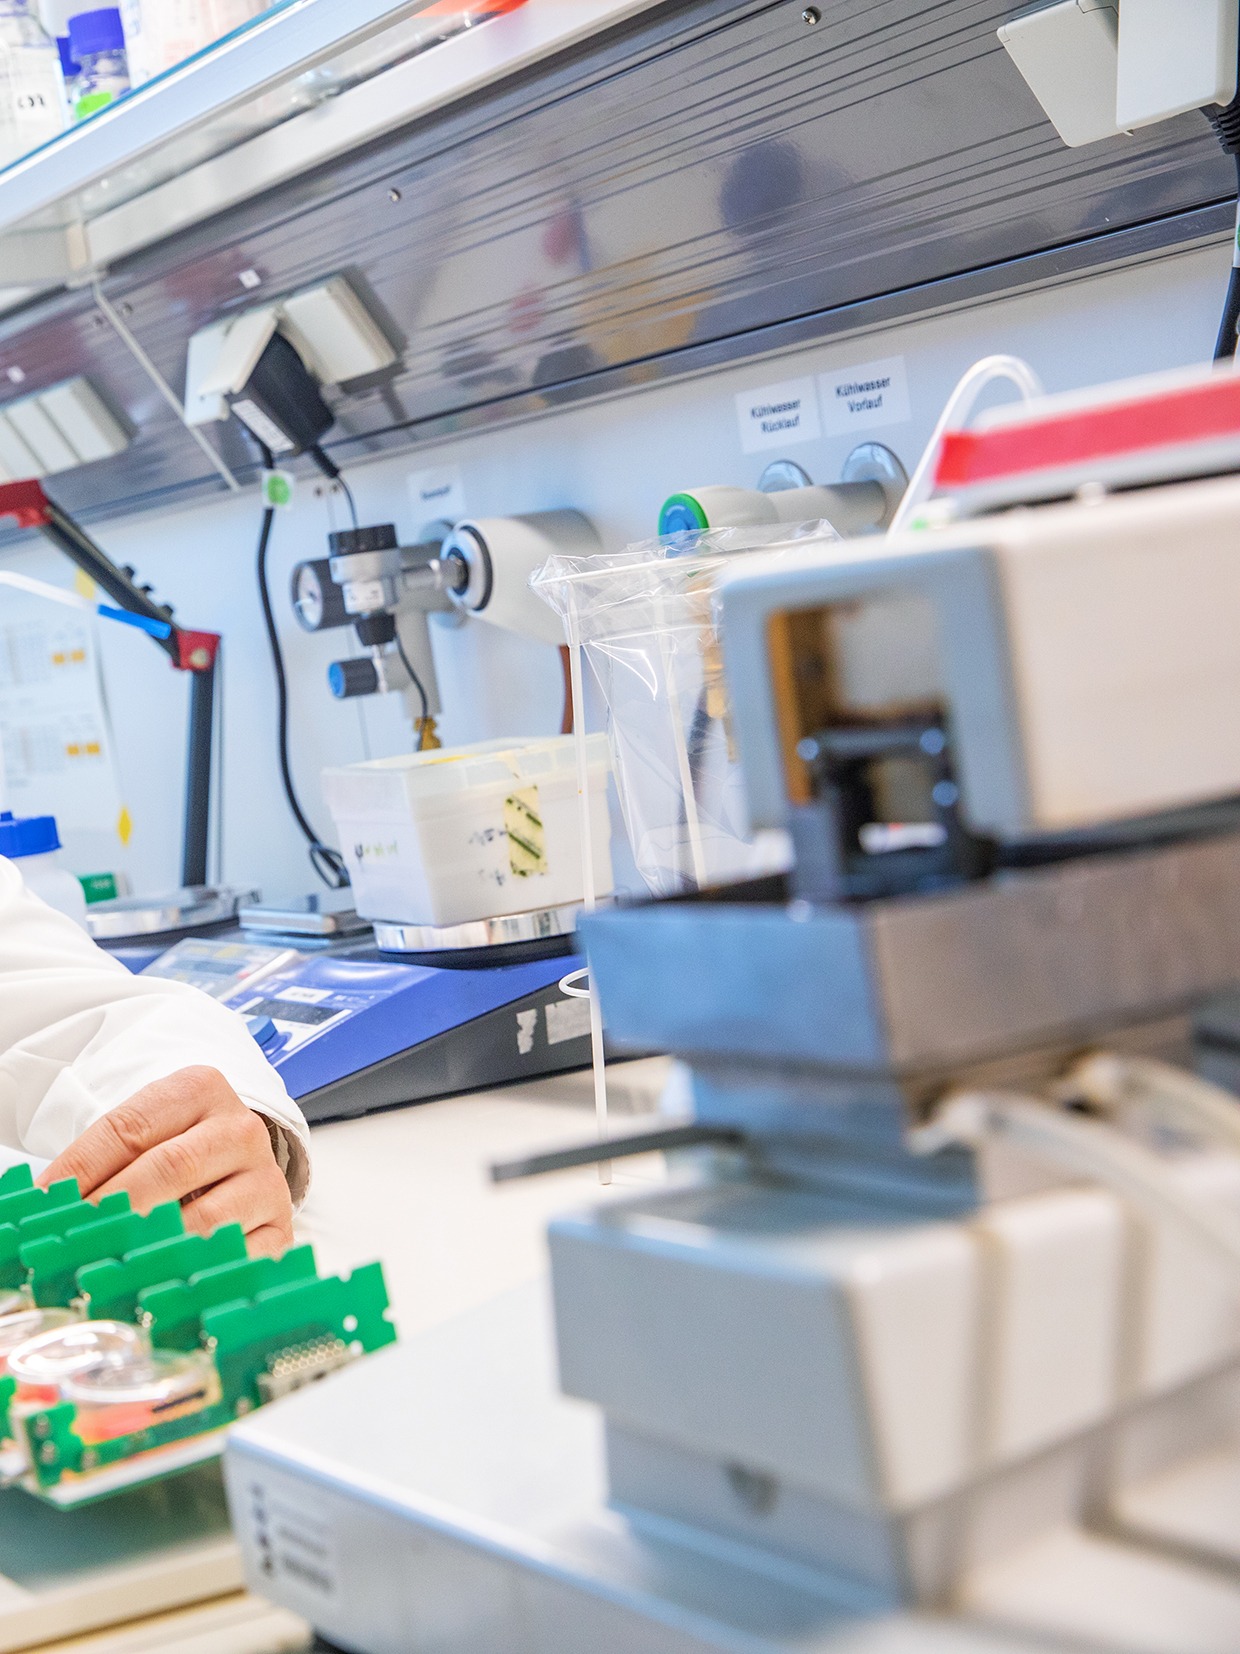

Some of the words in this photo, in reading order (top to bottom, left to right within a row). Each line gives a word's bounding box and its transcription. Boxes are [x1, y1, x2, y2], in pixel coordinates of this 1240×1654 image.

[836, 377, 891, 397] Kühlwasser
[751, 400, 800, 418] Kühlwasser
[847, 394, 883, 414] Vorlauf
[762, 415, 800, 433] Rücklauf
